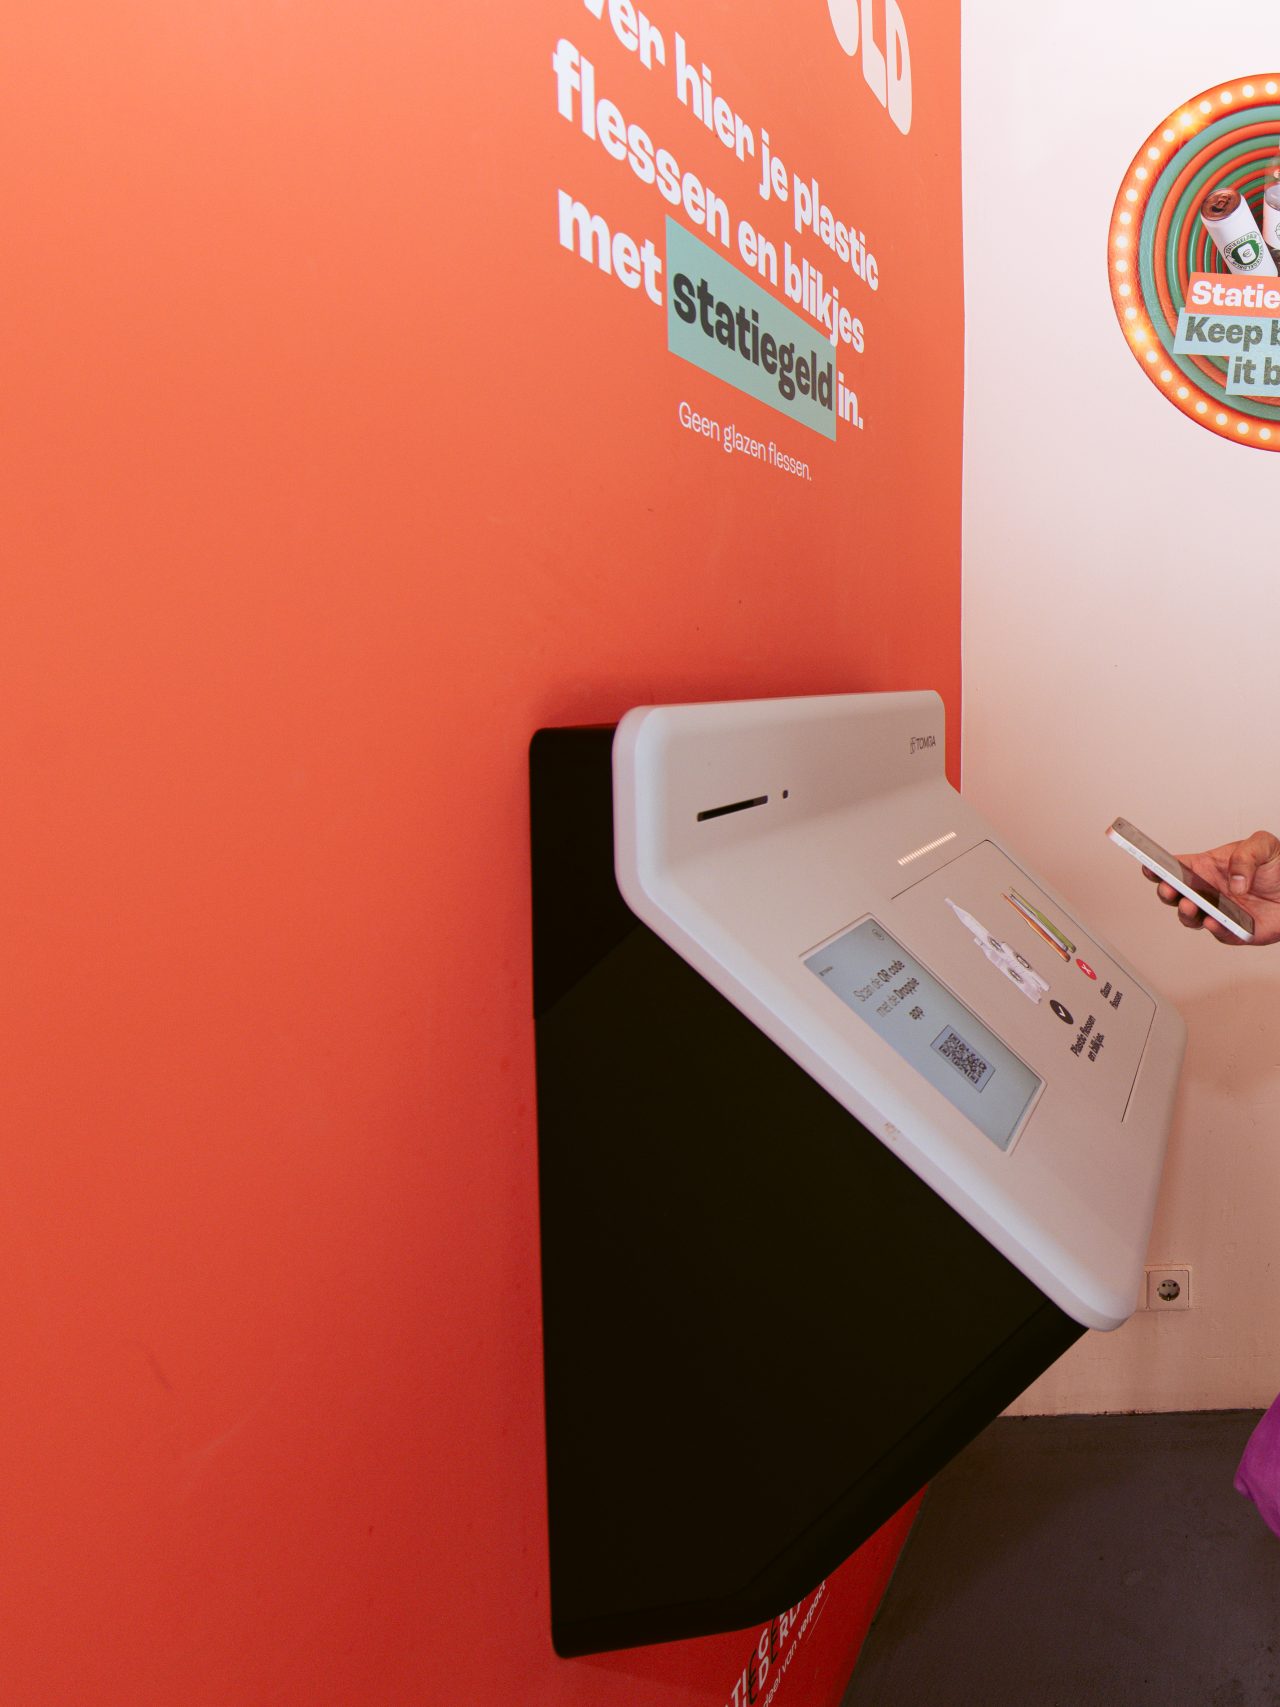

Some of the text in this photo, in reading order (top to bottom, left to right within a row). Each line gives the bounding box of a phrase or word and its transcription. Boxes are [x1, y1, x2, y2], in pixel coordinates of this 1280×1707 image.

[552, 37, 865, 354] flessen en blikjes
[675, 31, 755, 162] hier
[759, 127, 789, 203] je
[792, 172, 879, 292] plastic
[558, 188, 864, 430] met statiegeld in.
[1184, 315, 1263, 352] Keep
[1232, 355, 1255, 385] it
[678, 400, 812, 482] Geen glazen flessen.
[877, 969, 892, 982] QR
[888, 959, 904, 975] code
